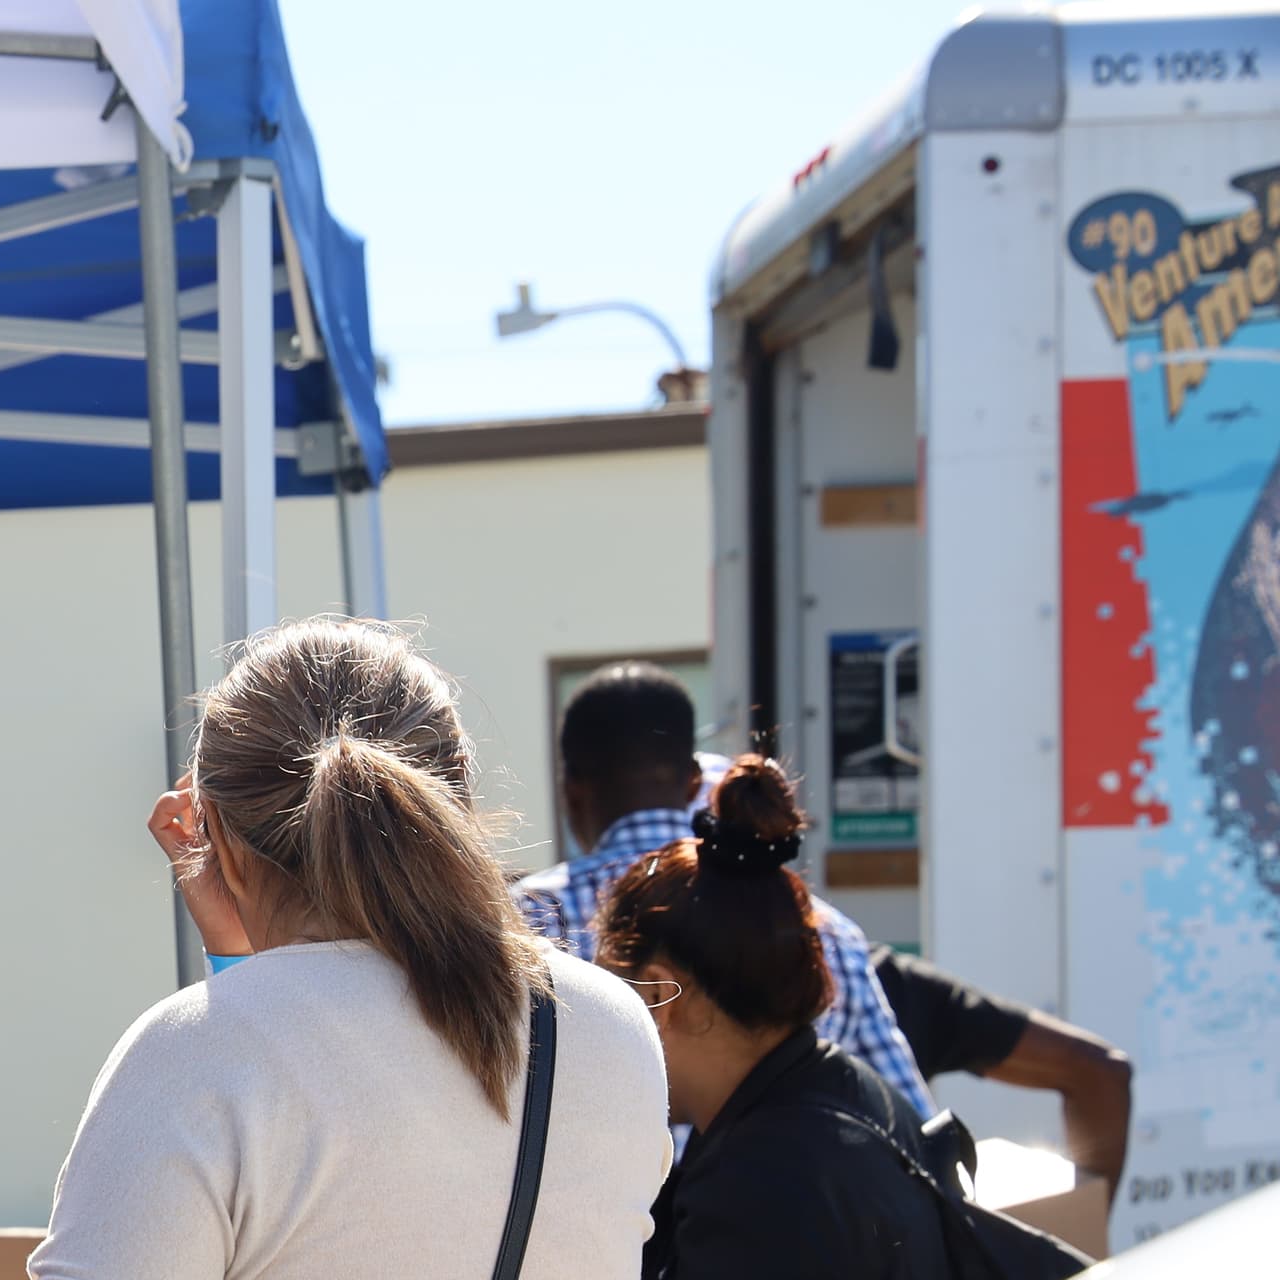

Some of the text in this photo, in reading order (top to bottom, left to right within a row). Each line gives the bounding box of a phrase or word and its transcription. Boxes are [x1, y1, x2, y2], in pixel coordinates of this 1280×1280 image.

[1092, 48, 1260, 86] DC 1005 X
[1082, 208, 1157, 258] #90
[1093, 208, 1263, 342] Venture
[1160, 240, 1280, 425] Ame
[1130, 1175, 1174, 1205] DID
[1182, 1166, 1236, 1197] YOU
